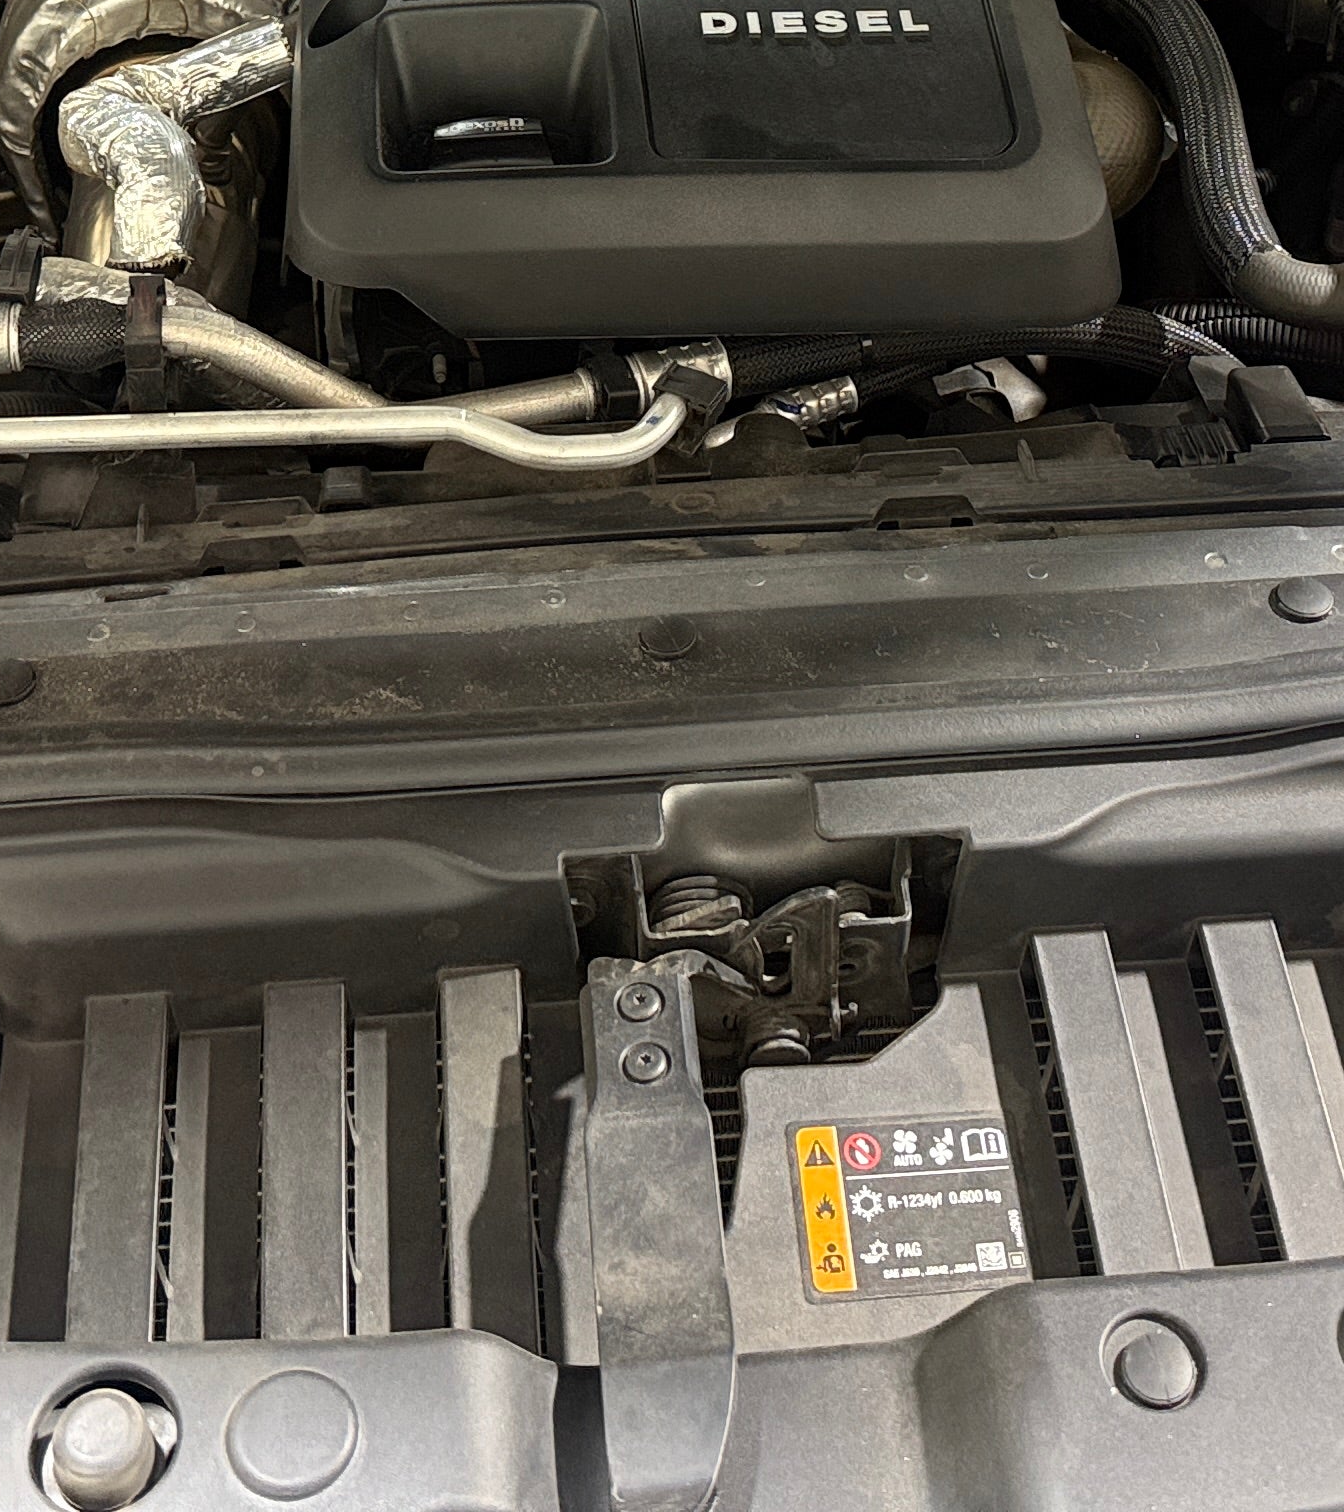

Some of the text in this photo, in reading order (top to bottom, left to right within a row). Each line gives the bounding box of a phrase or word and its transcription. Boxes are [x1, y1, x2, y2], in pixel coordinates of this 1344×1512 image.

[700, 9, 930, 35] DIESEL
[893, 1153, 923, 1167] AUTO
[887, 1191, 943, 1209] R-1234yf
[984, 1188, 1002, 1204] kg
[895, 1241, 923, 1259] PAG
